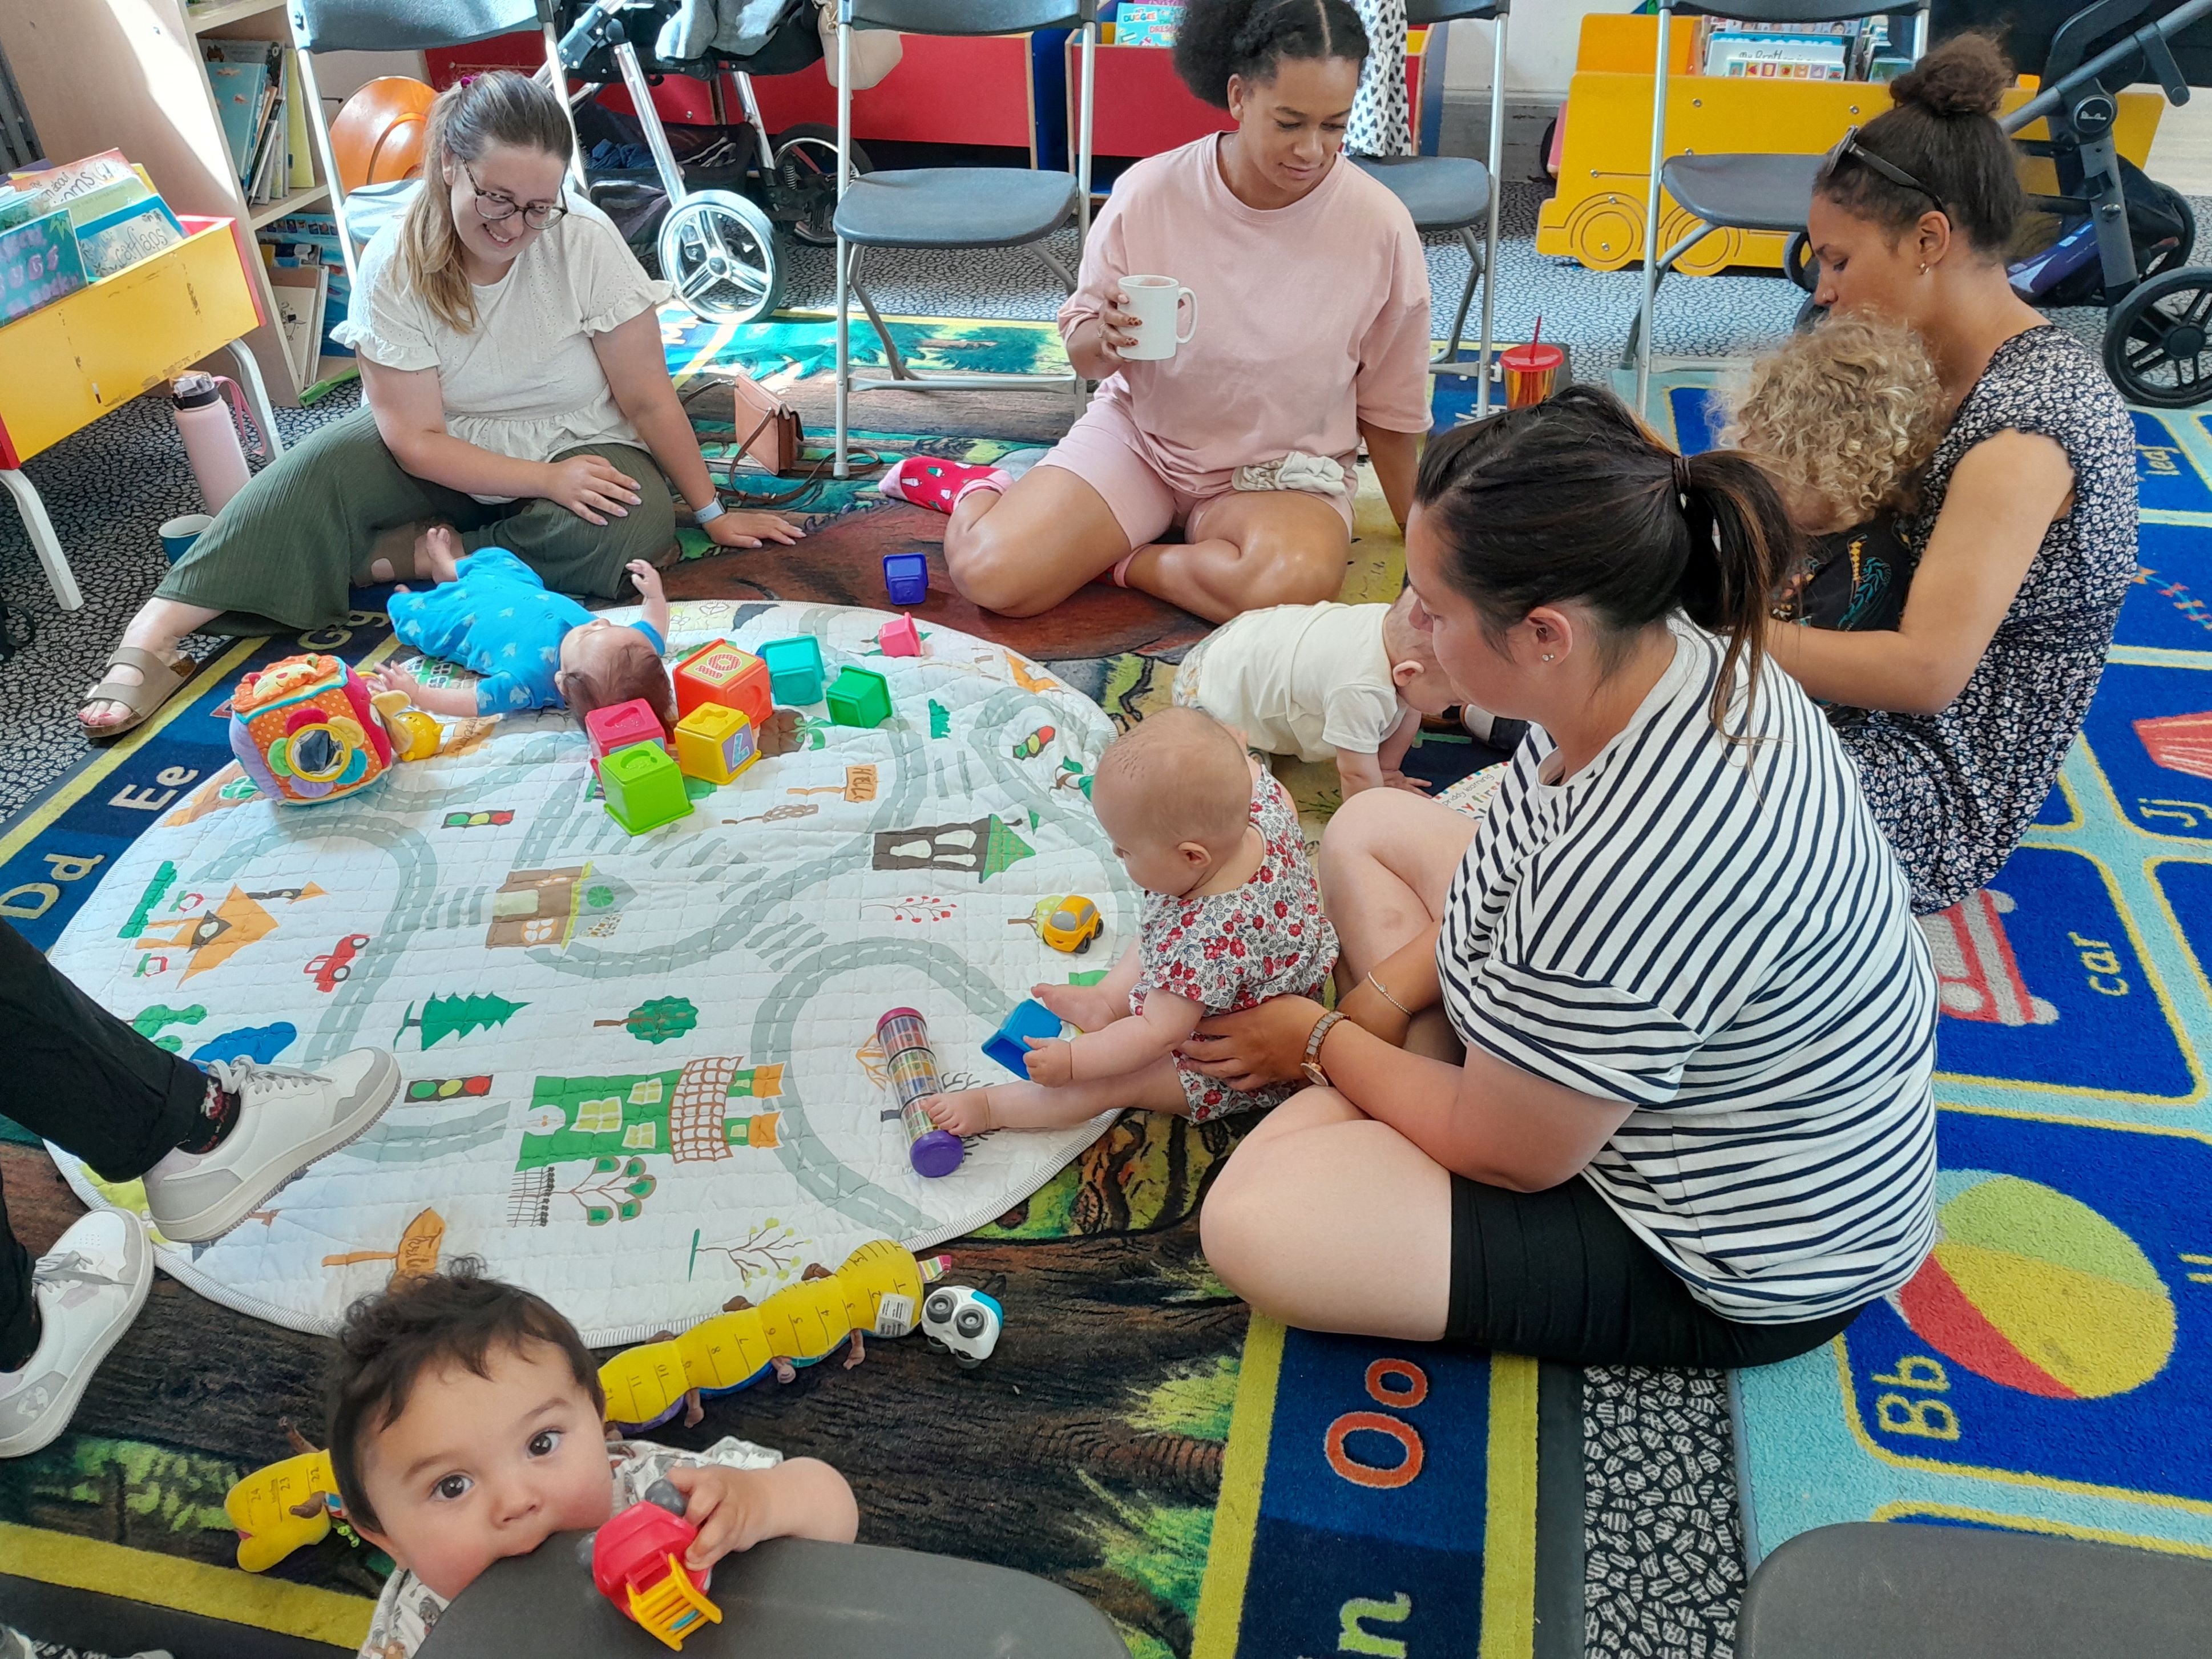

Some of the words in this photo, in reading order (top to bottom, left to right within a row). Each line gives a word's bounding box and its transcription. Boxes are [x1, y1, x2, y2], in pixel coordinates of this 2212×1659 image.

[694, 653, 741, 680] 10
[107, 765, 199, 812] Ee
[1462, 773, 1495, 793] learning
[0, 853, 106, 920] Dd
[2066, 931, 2130, 997] car
[1325, 1358, 1428, 1488] Oo
[1871, 1356, 1961, 1442] Bb
